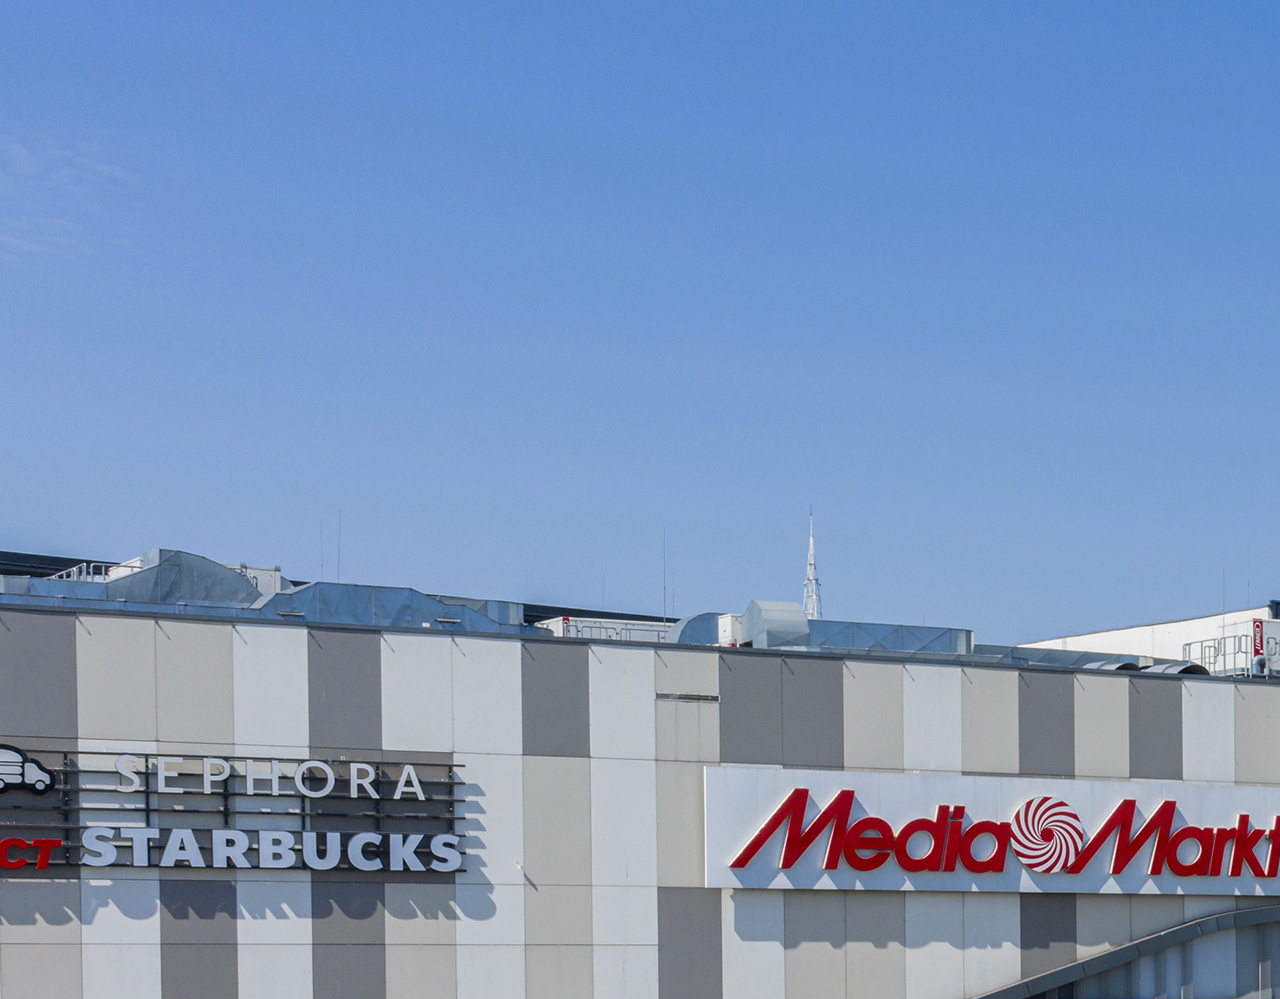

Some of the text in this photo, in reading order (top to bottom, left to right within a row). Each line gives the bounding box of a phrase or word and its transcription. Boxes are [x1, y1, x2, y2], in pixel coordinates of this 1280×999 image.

[115, 754, 426, 800] SEPHORA
[81, 827, 463, 872] STARBUCKS
[729, 788, 1009, 873] Media
